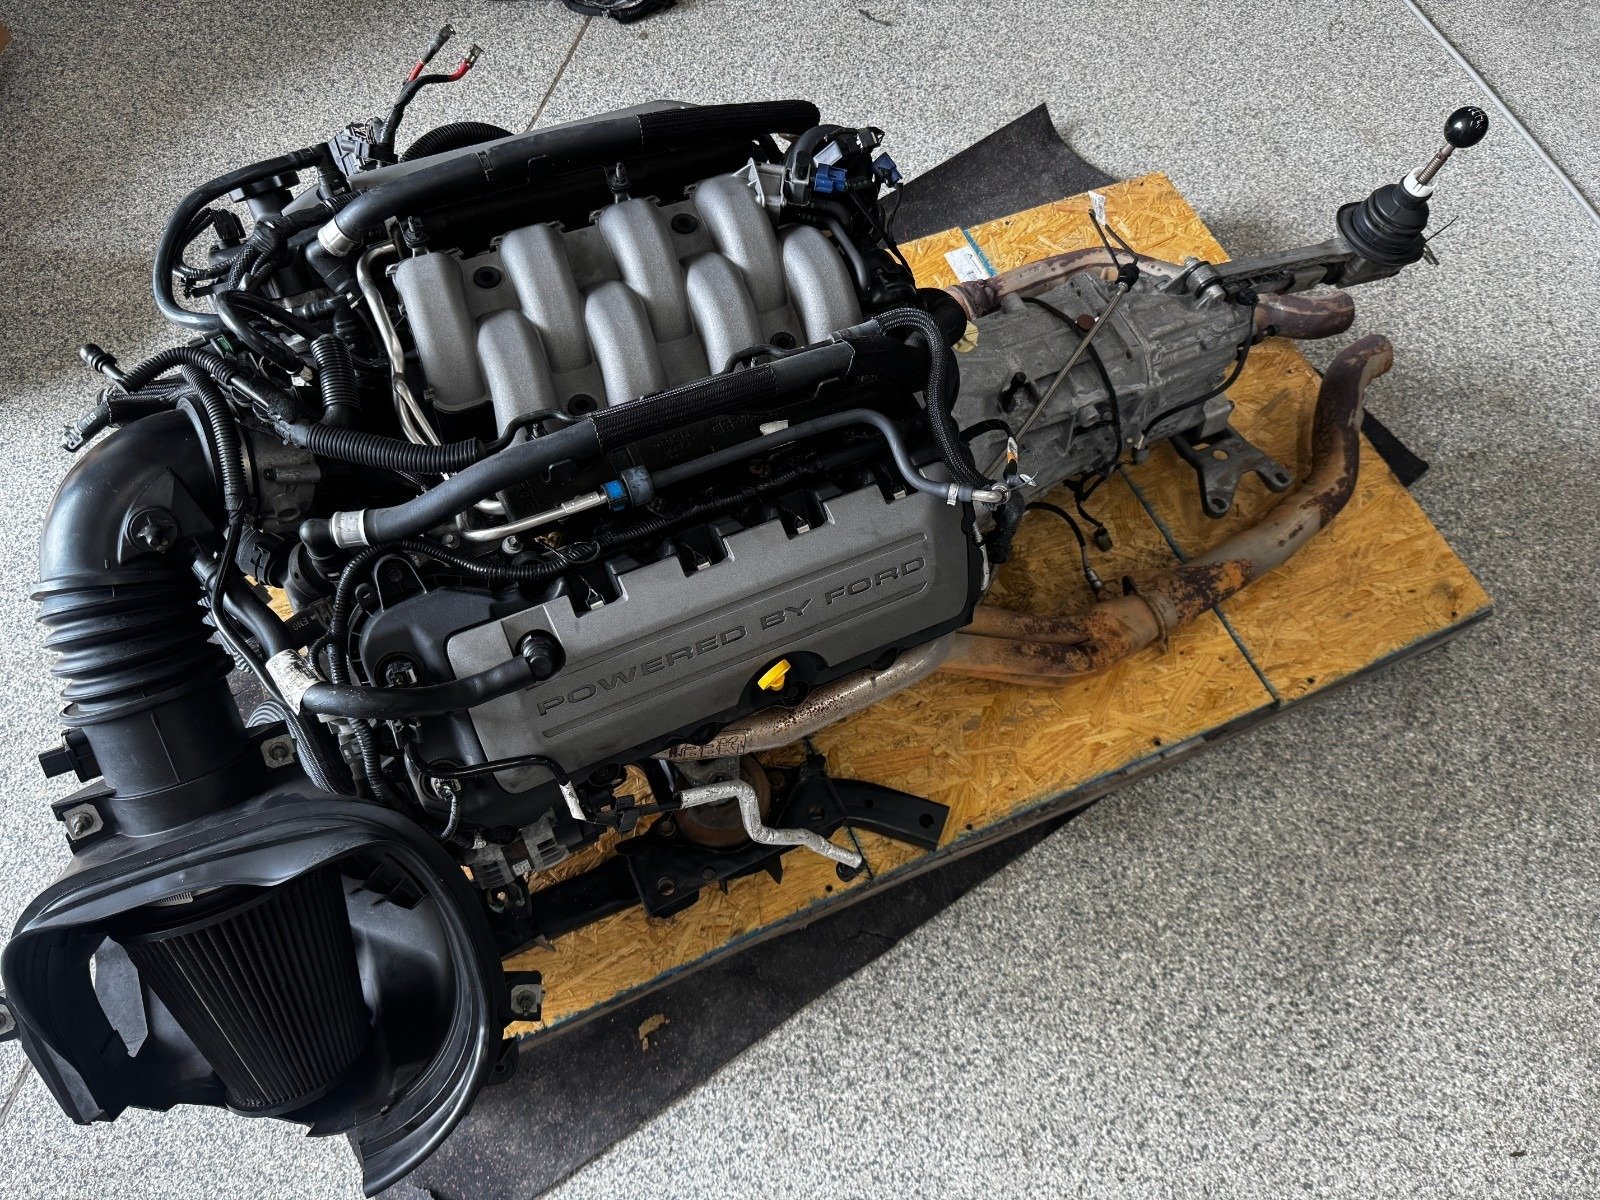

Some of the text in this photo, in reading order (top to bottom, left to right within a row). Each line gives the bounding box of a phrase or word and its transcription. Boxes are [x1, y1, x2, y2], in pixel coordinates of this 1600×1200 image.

[536, 555, 926, 717] POWERED BY FORD
